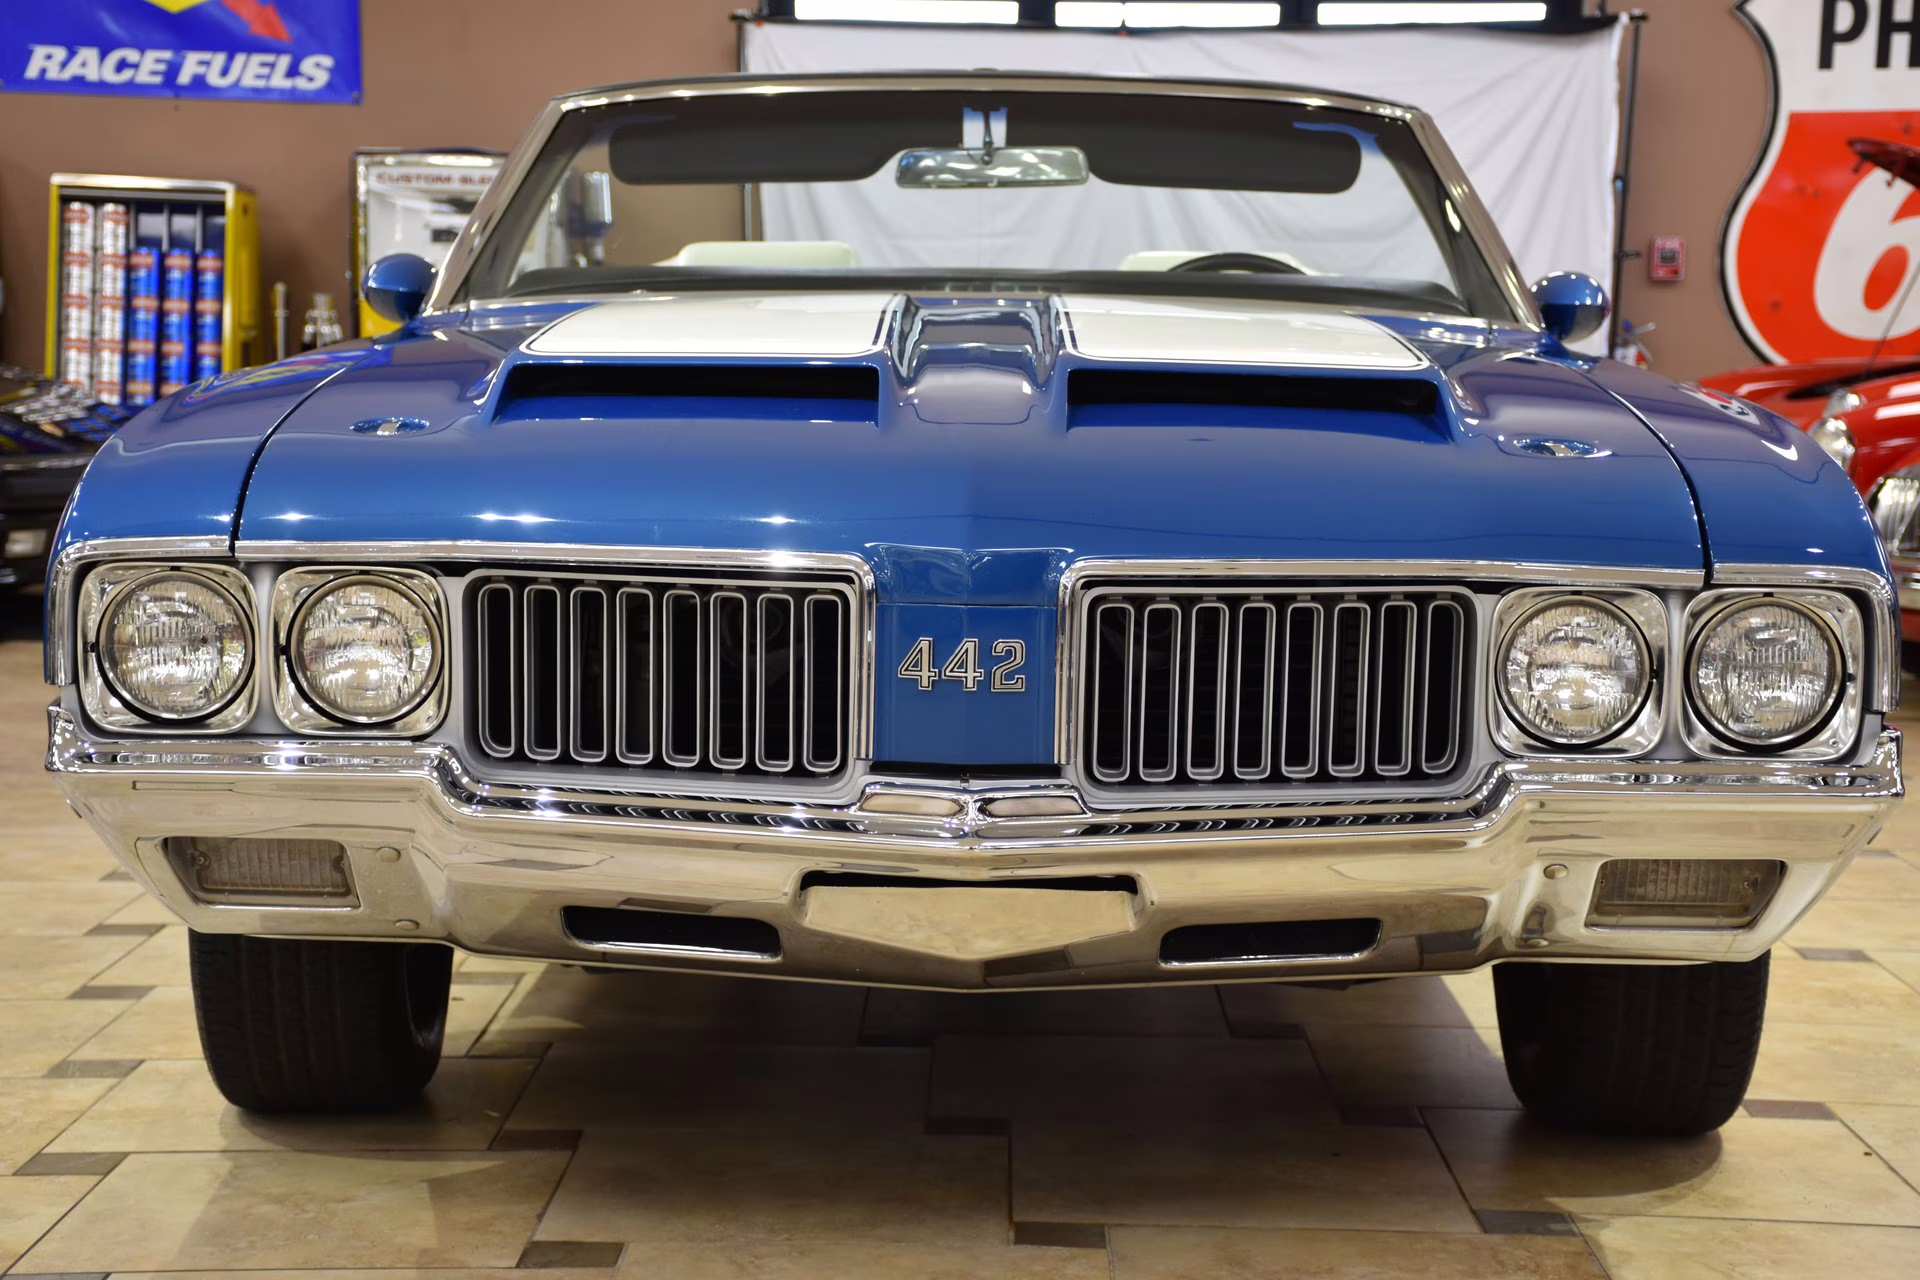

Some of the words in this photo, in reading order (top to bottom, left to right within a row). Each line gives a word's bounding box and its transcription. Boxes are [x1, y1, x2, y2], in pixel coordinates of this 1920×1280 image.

[24, 44, 173, 85] RACE
[176, 50, 335, 90] FUELS
[376, 171, 452, 185] CUSTOM
[898, 637, 1026, 692] 442
